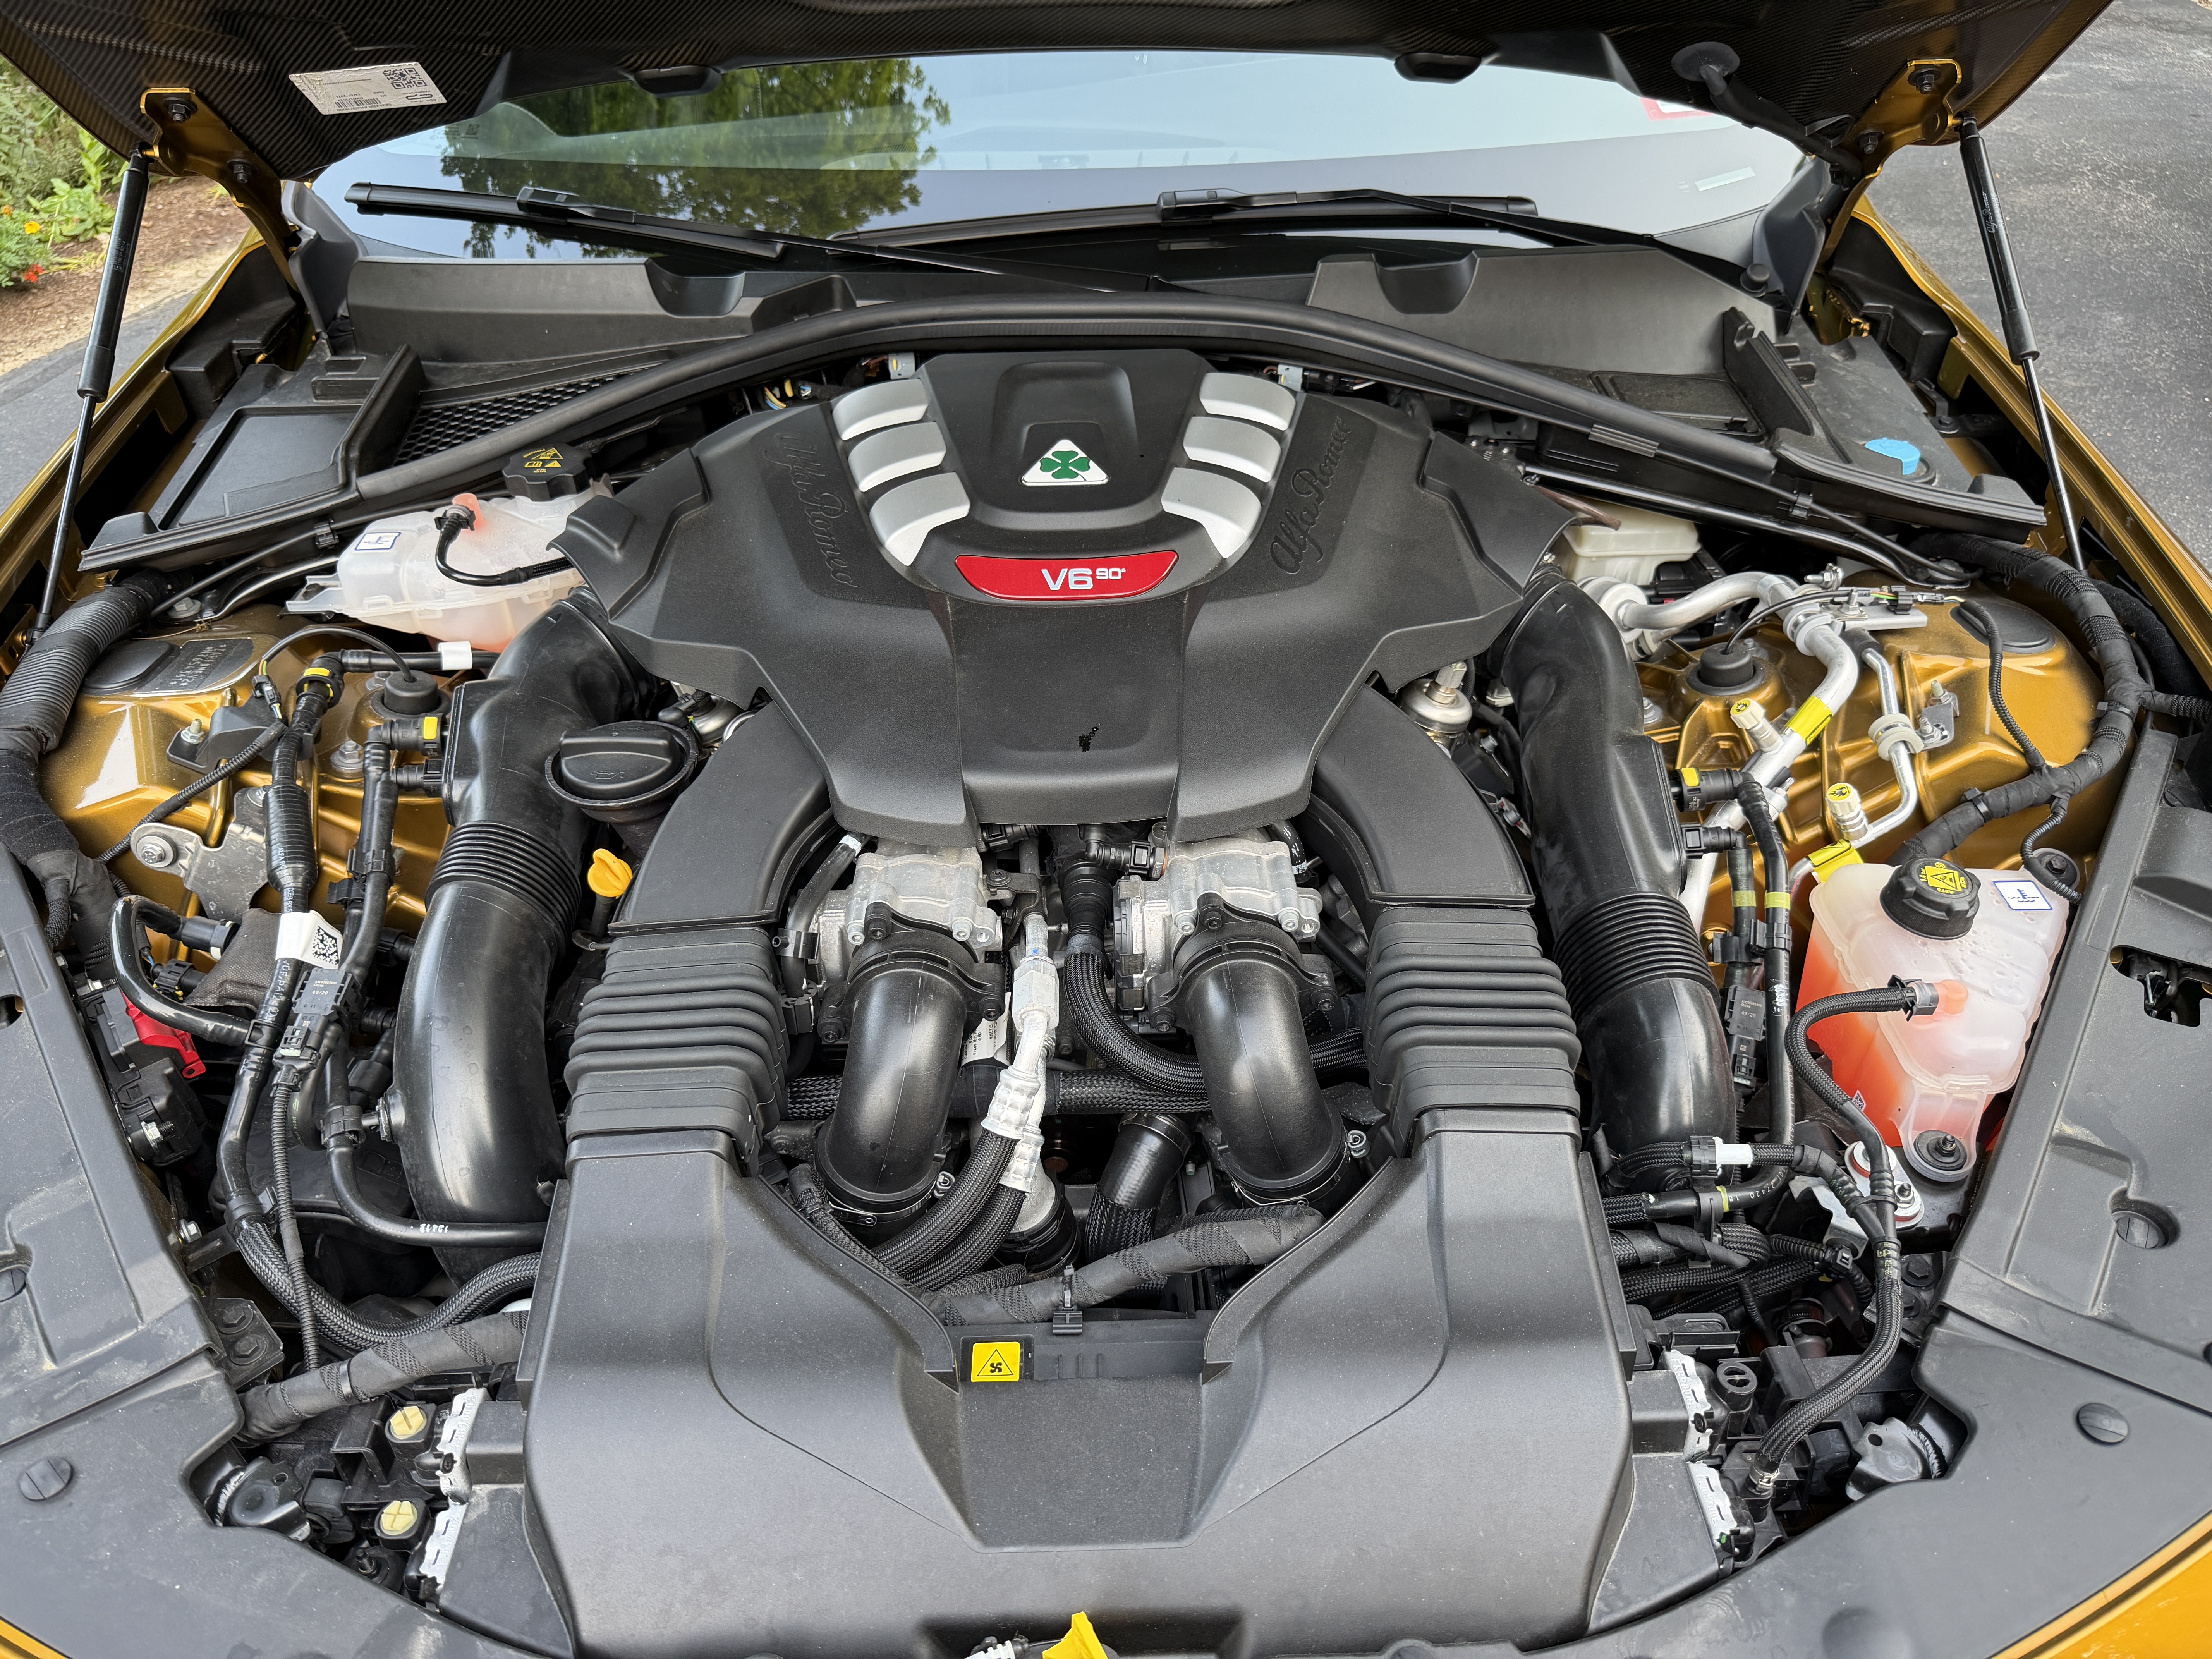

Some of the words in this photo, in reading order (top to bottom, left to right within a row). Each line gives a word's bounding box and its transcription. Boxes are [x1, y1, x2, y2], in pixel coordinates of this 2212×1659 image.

[1981, 191, 1991, 216] Romeo
[1986, 214, 1997, 234] Alfa
[1291, 416, 1352, 506] Romeo
[797, 488, 858, 587] Romeo
[1270, 508, 1324, 574] Alfa
[1042, 568, 1092, 591] V6
